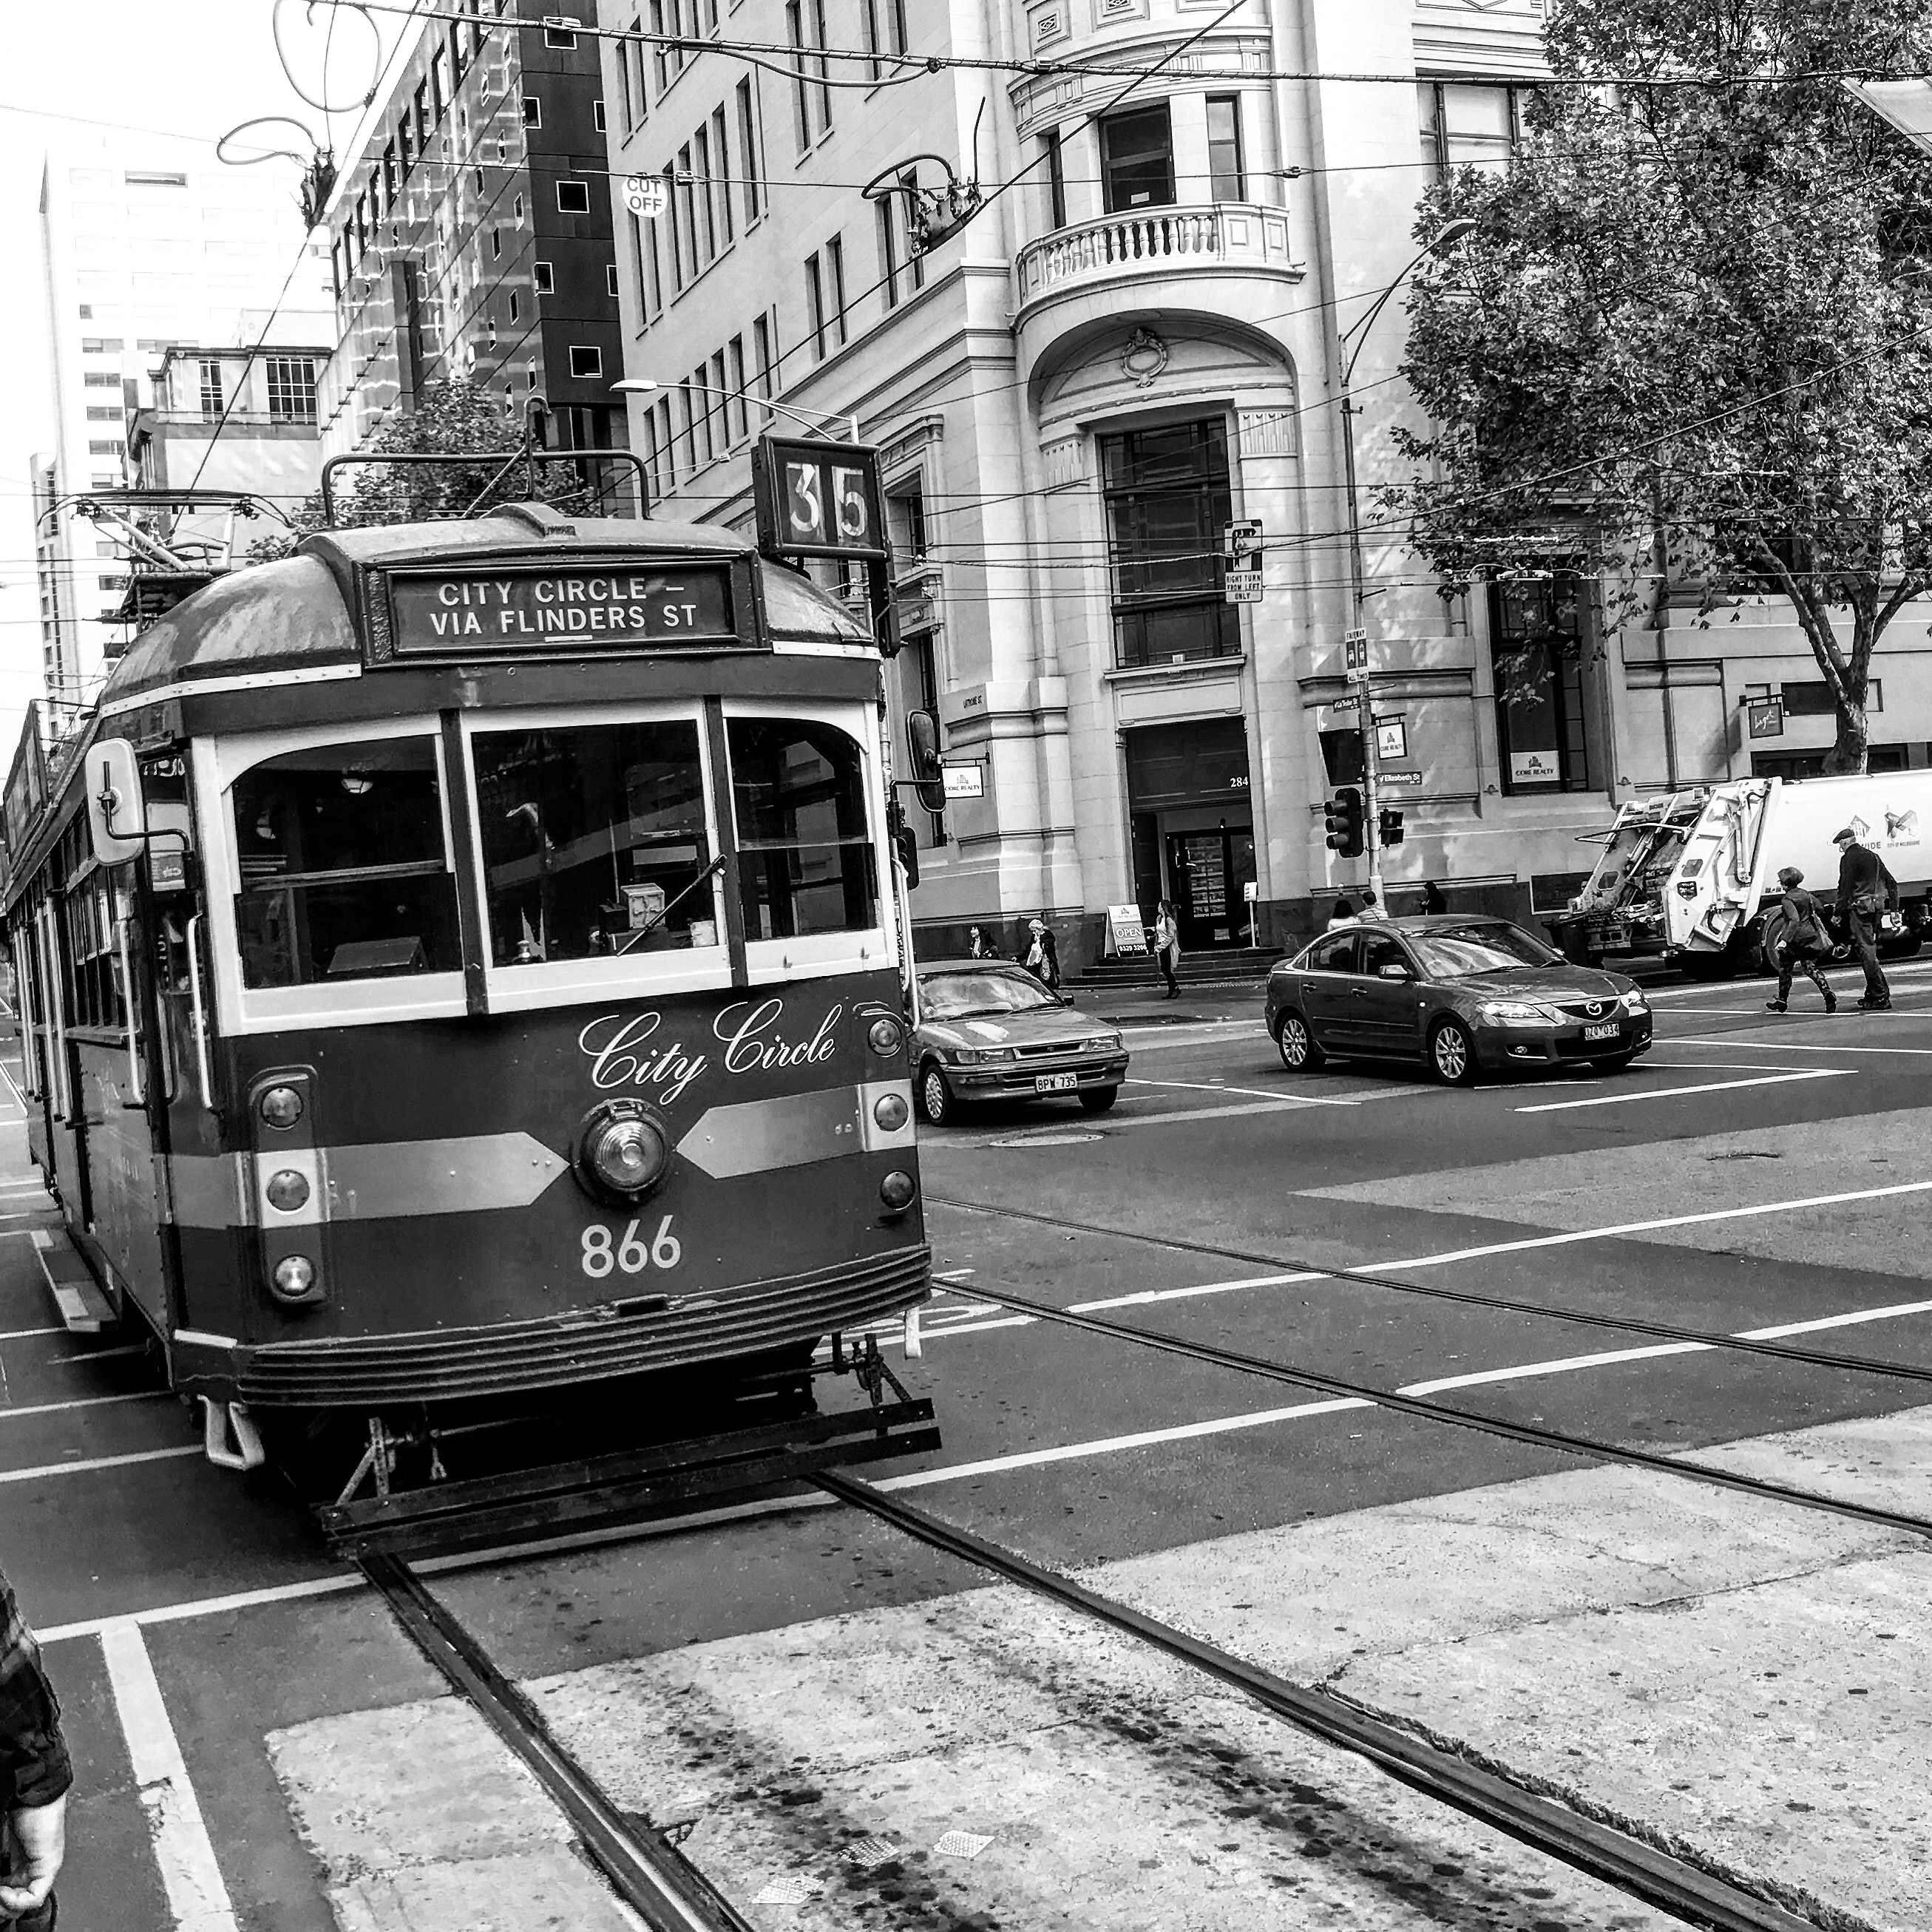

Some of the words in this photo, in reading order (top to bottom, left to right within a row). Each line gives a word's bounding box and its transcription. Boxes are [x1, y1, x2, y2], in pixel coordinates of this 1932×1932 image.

[627, 177, 661, 194] CUT
[629, 196, 662, 211] OFF
[1227, 575, 1242, 583] RIGHT
[1244, 574, 1261, 583] TURN
[438, 581, 512, 606] CITY
[535, 577, 646, 603] CIRCLE
[1245, 583, 1260, 591] LEFT
[1235, 592, 1250, 600] ONLY
[430, 612, 482, 635] VIA
[501, 606, 645, 633] FLINDERS
[663, 604, 696, 627] ST
[1230, 776, 1248, 787] 284
[1116, 927, 1142, 938] OPEN
[579, 1011, 708, 1105] City
[713, 999, 842, 1073] Circle
[581, 1215, 681, 1278] 866
